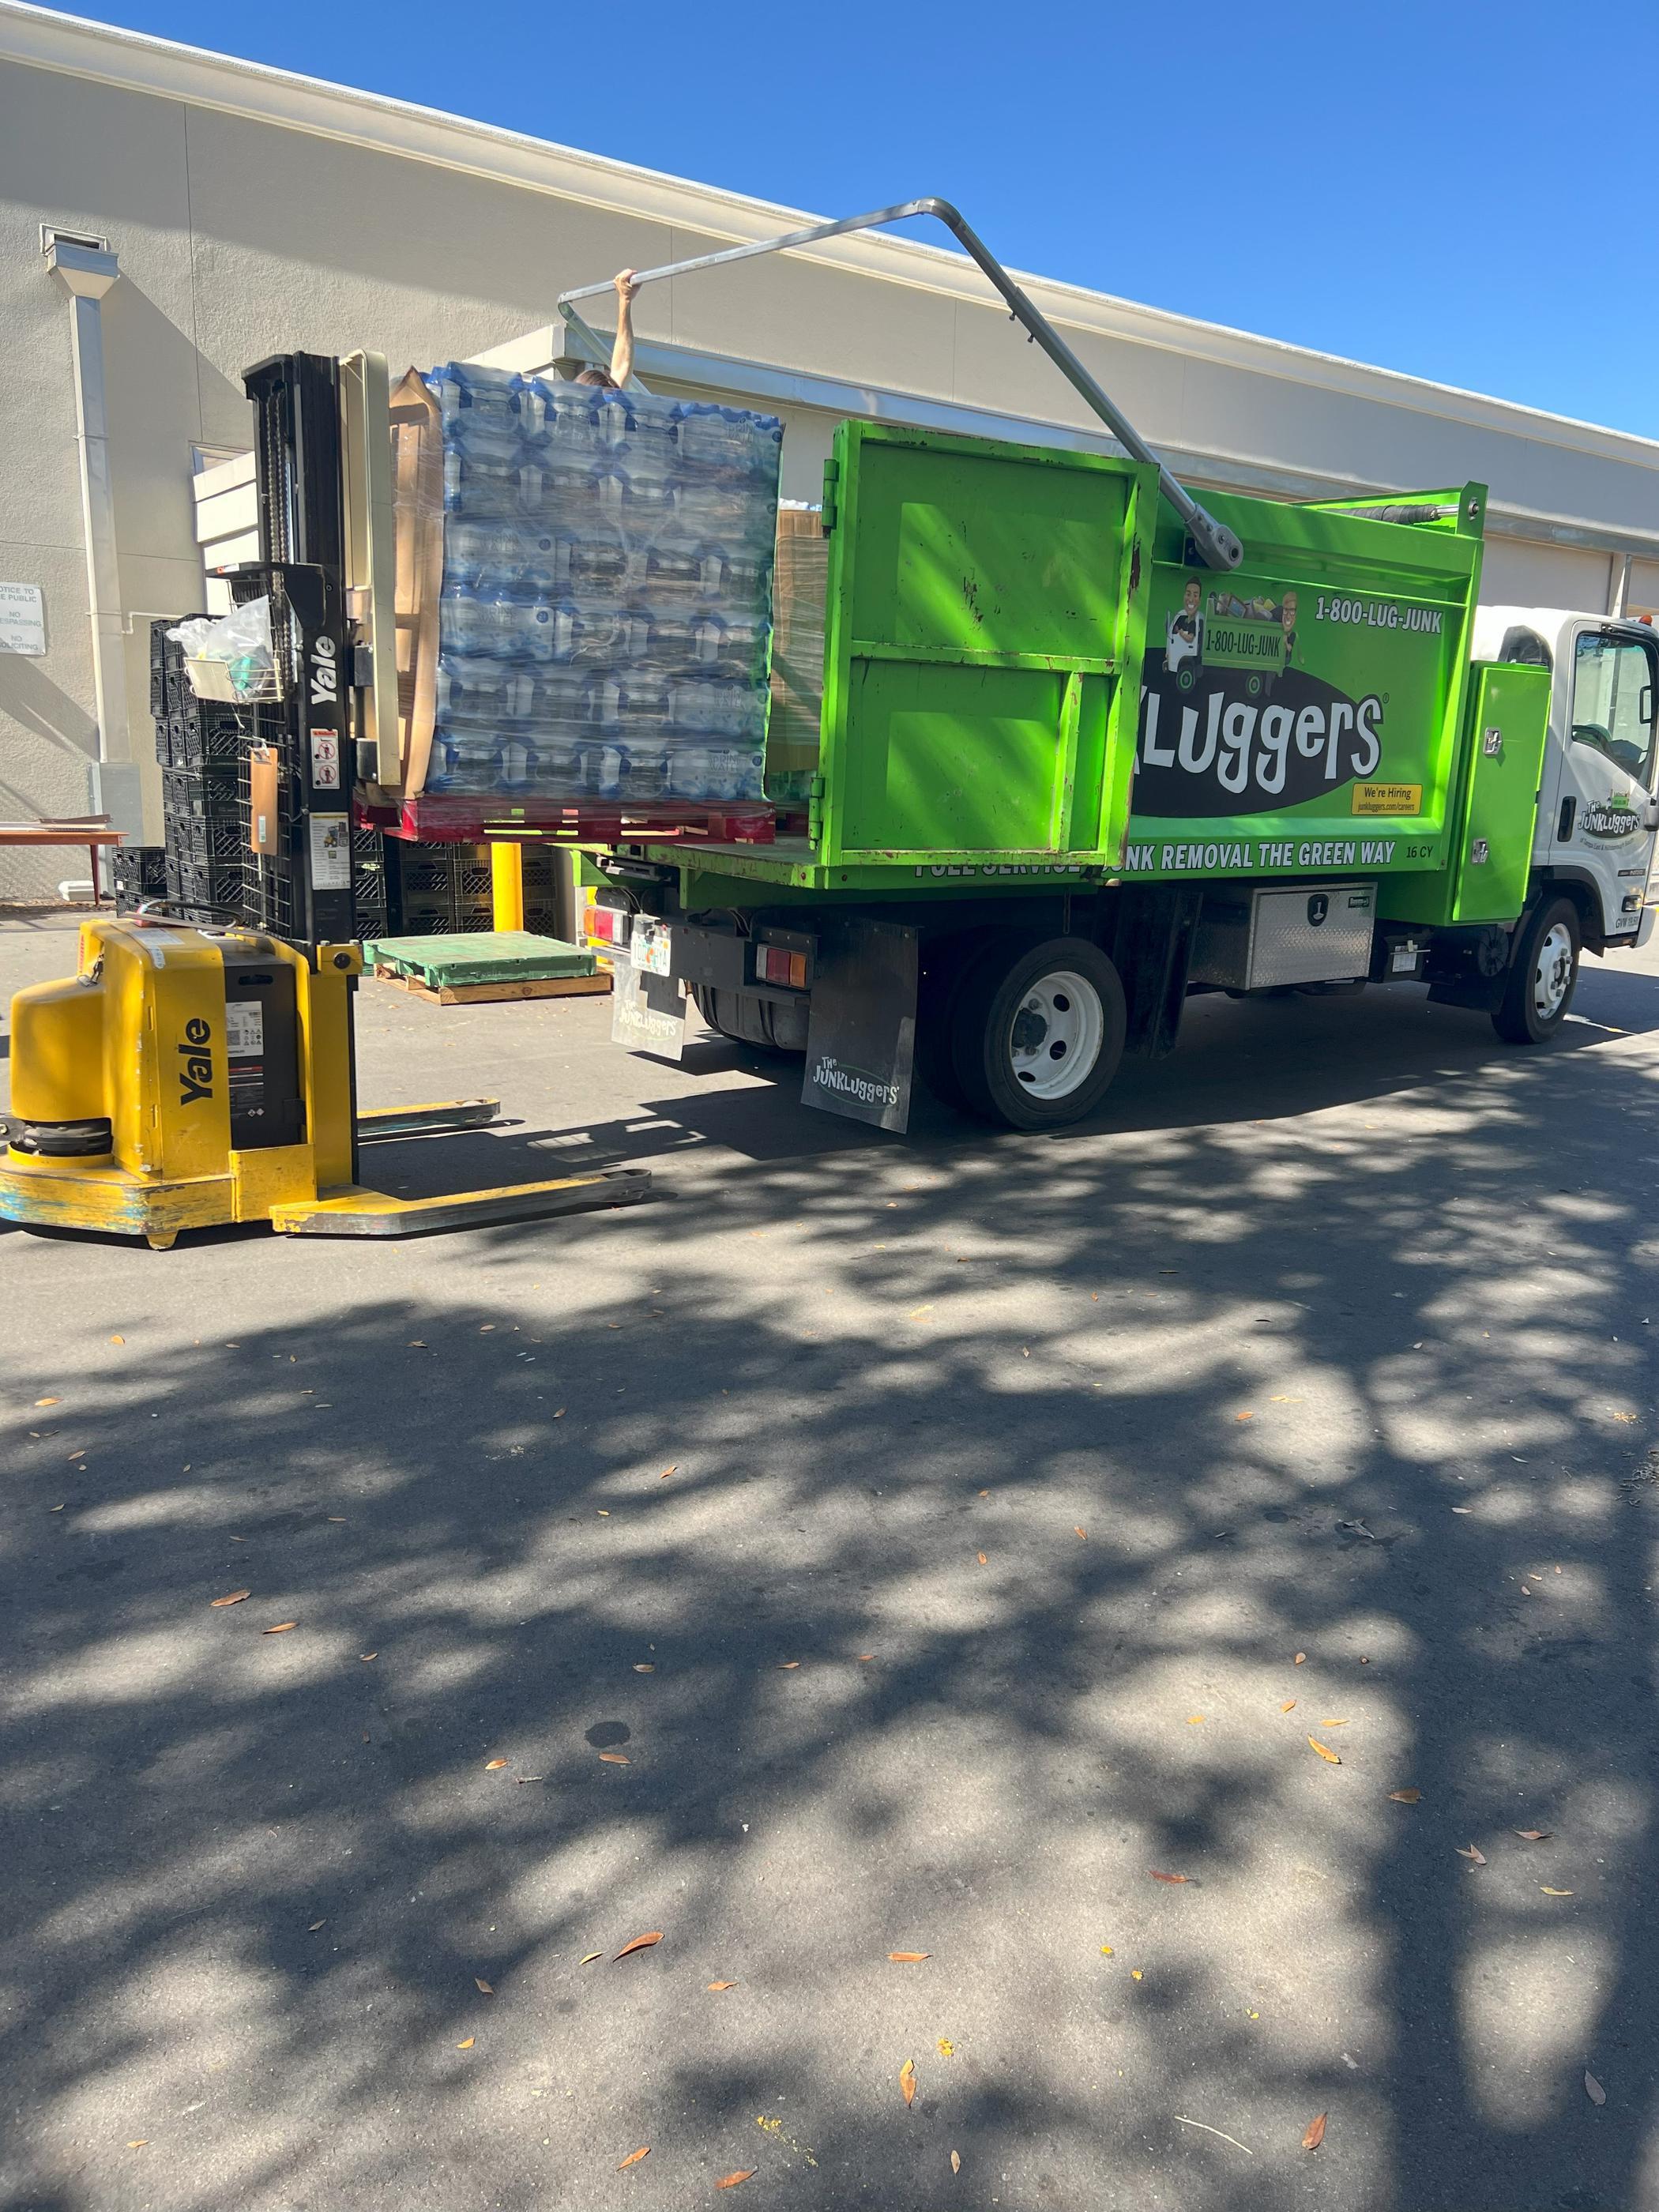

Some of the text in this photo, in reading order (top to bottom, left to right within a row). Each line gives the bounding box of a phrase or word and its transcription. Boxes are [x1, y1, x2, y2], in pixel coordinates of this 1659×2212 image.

[9, 594, 37, 603] PUBLIC
[0, 618, 42, 627] ESPASSING
[1315, 596, 1442, 634] 1-800-LUG-JUNK
[0, 641, 38, 651] OLICITING
[1205, 629, 1281, 658] 1-800-LUG-JUNK
[310, 635, 337, 705] Yale
[1135, 685, 1382, 795] LUggers
[1364, 788, 1412, 800] We're Hiring
[1161, 842, 1254, 870] REMOVAL
[1258, 841, 1295, 867] THE
[1298, 841, 1357, 866] GREEN
[1360, 840, 1397, 865] WAY
[1406, 845, 1434, 859] 16 CY
[178, 1018, 213, 1106] Yale
